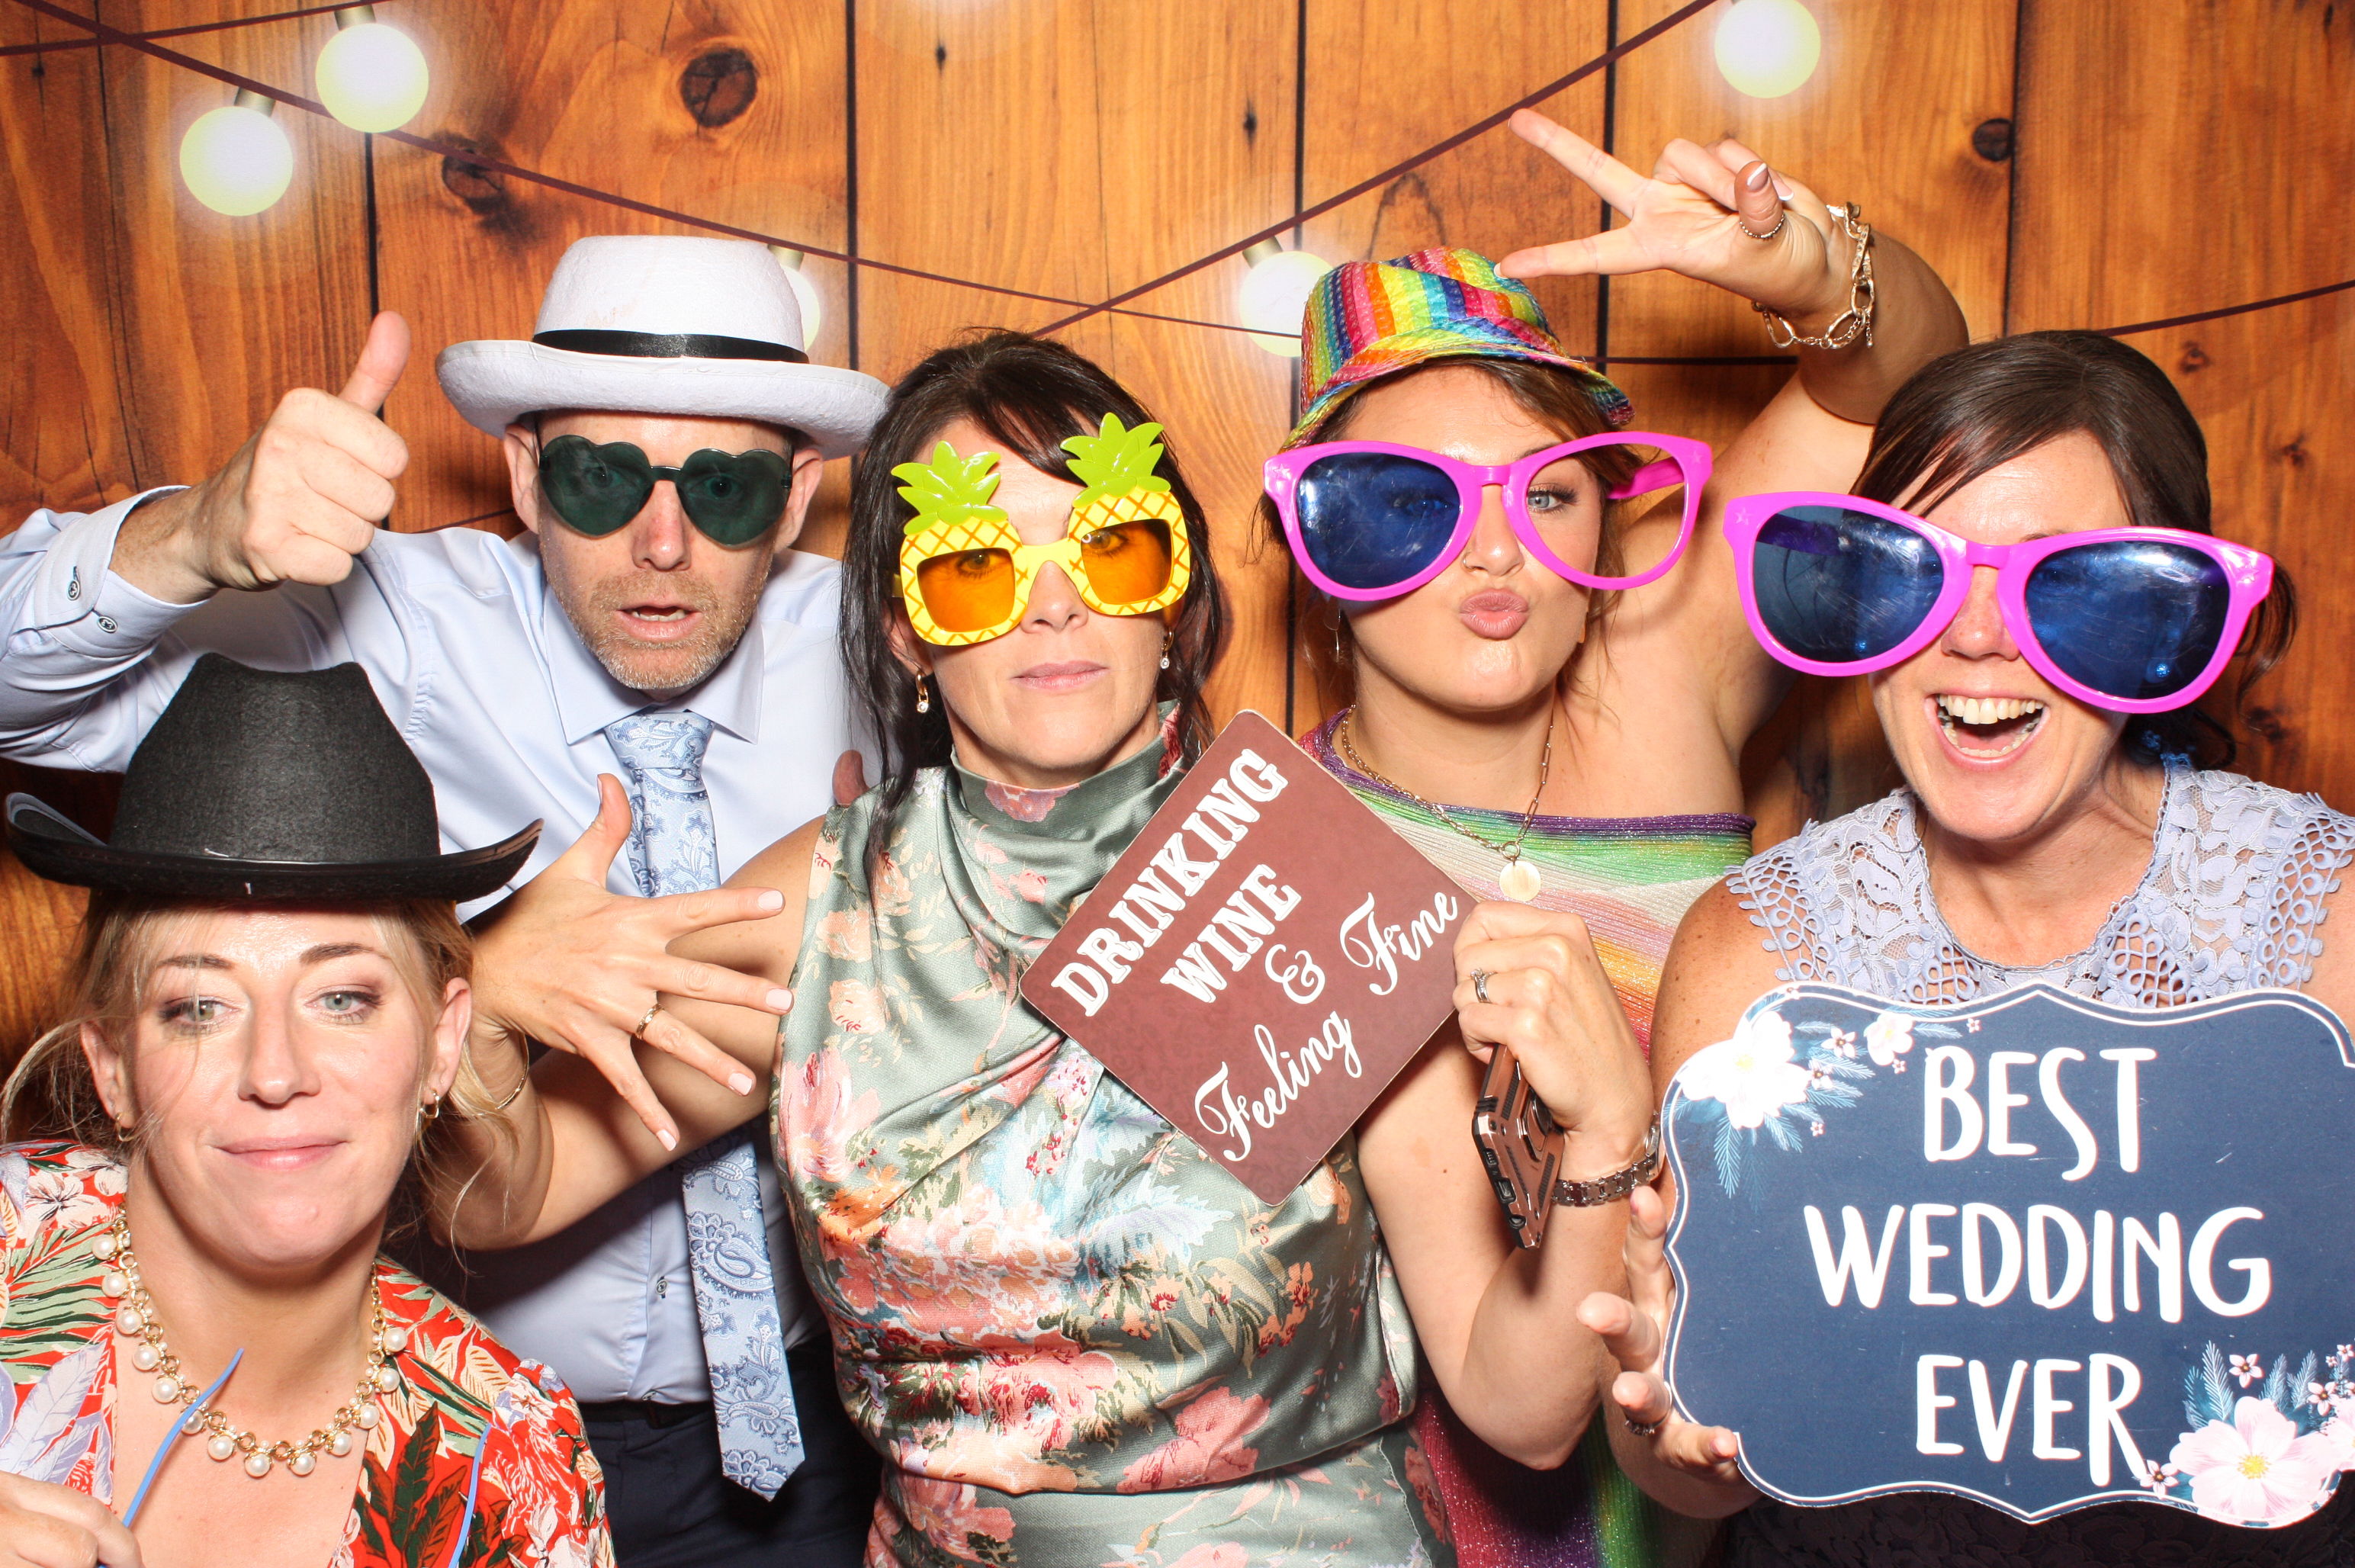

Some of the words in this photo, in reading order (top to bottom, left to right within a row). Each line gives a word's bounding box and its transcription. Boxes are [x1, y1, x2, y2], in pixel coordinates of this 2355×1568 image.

[1050, 748, 1289, 1017] DRINKING
[1160, 863, 1303, 1004] WINE
[1194, 1011, 1363, 1162] Feeling
[1339, 892, 1458, 996] Fine
[1264, 943, 1326, 1005] &
[1923, 1044, 2157, 1181] BEST
[1803, 1202, 2271, 1323] WEDDING
[1916, 1353, 2147, 1487] EVER
